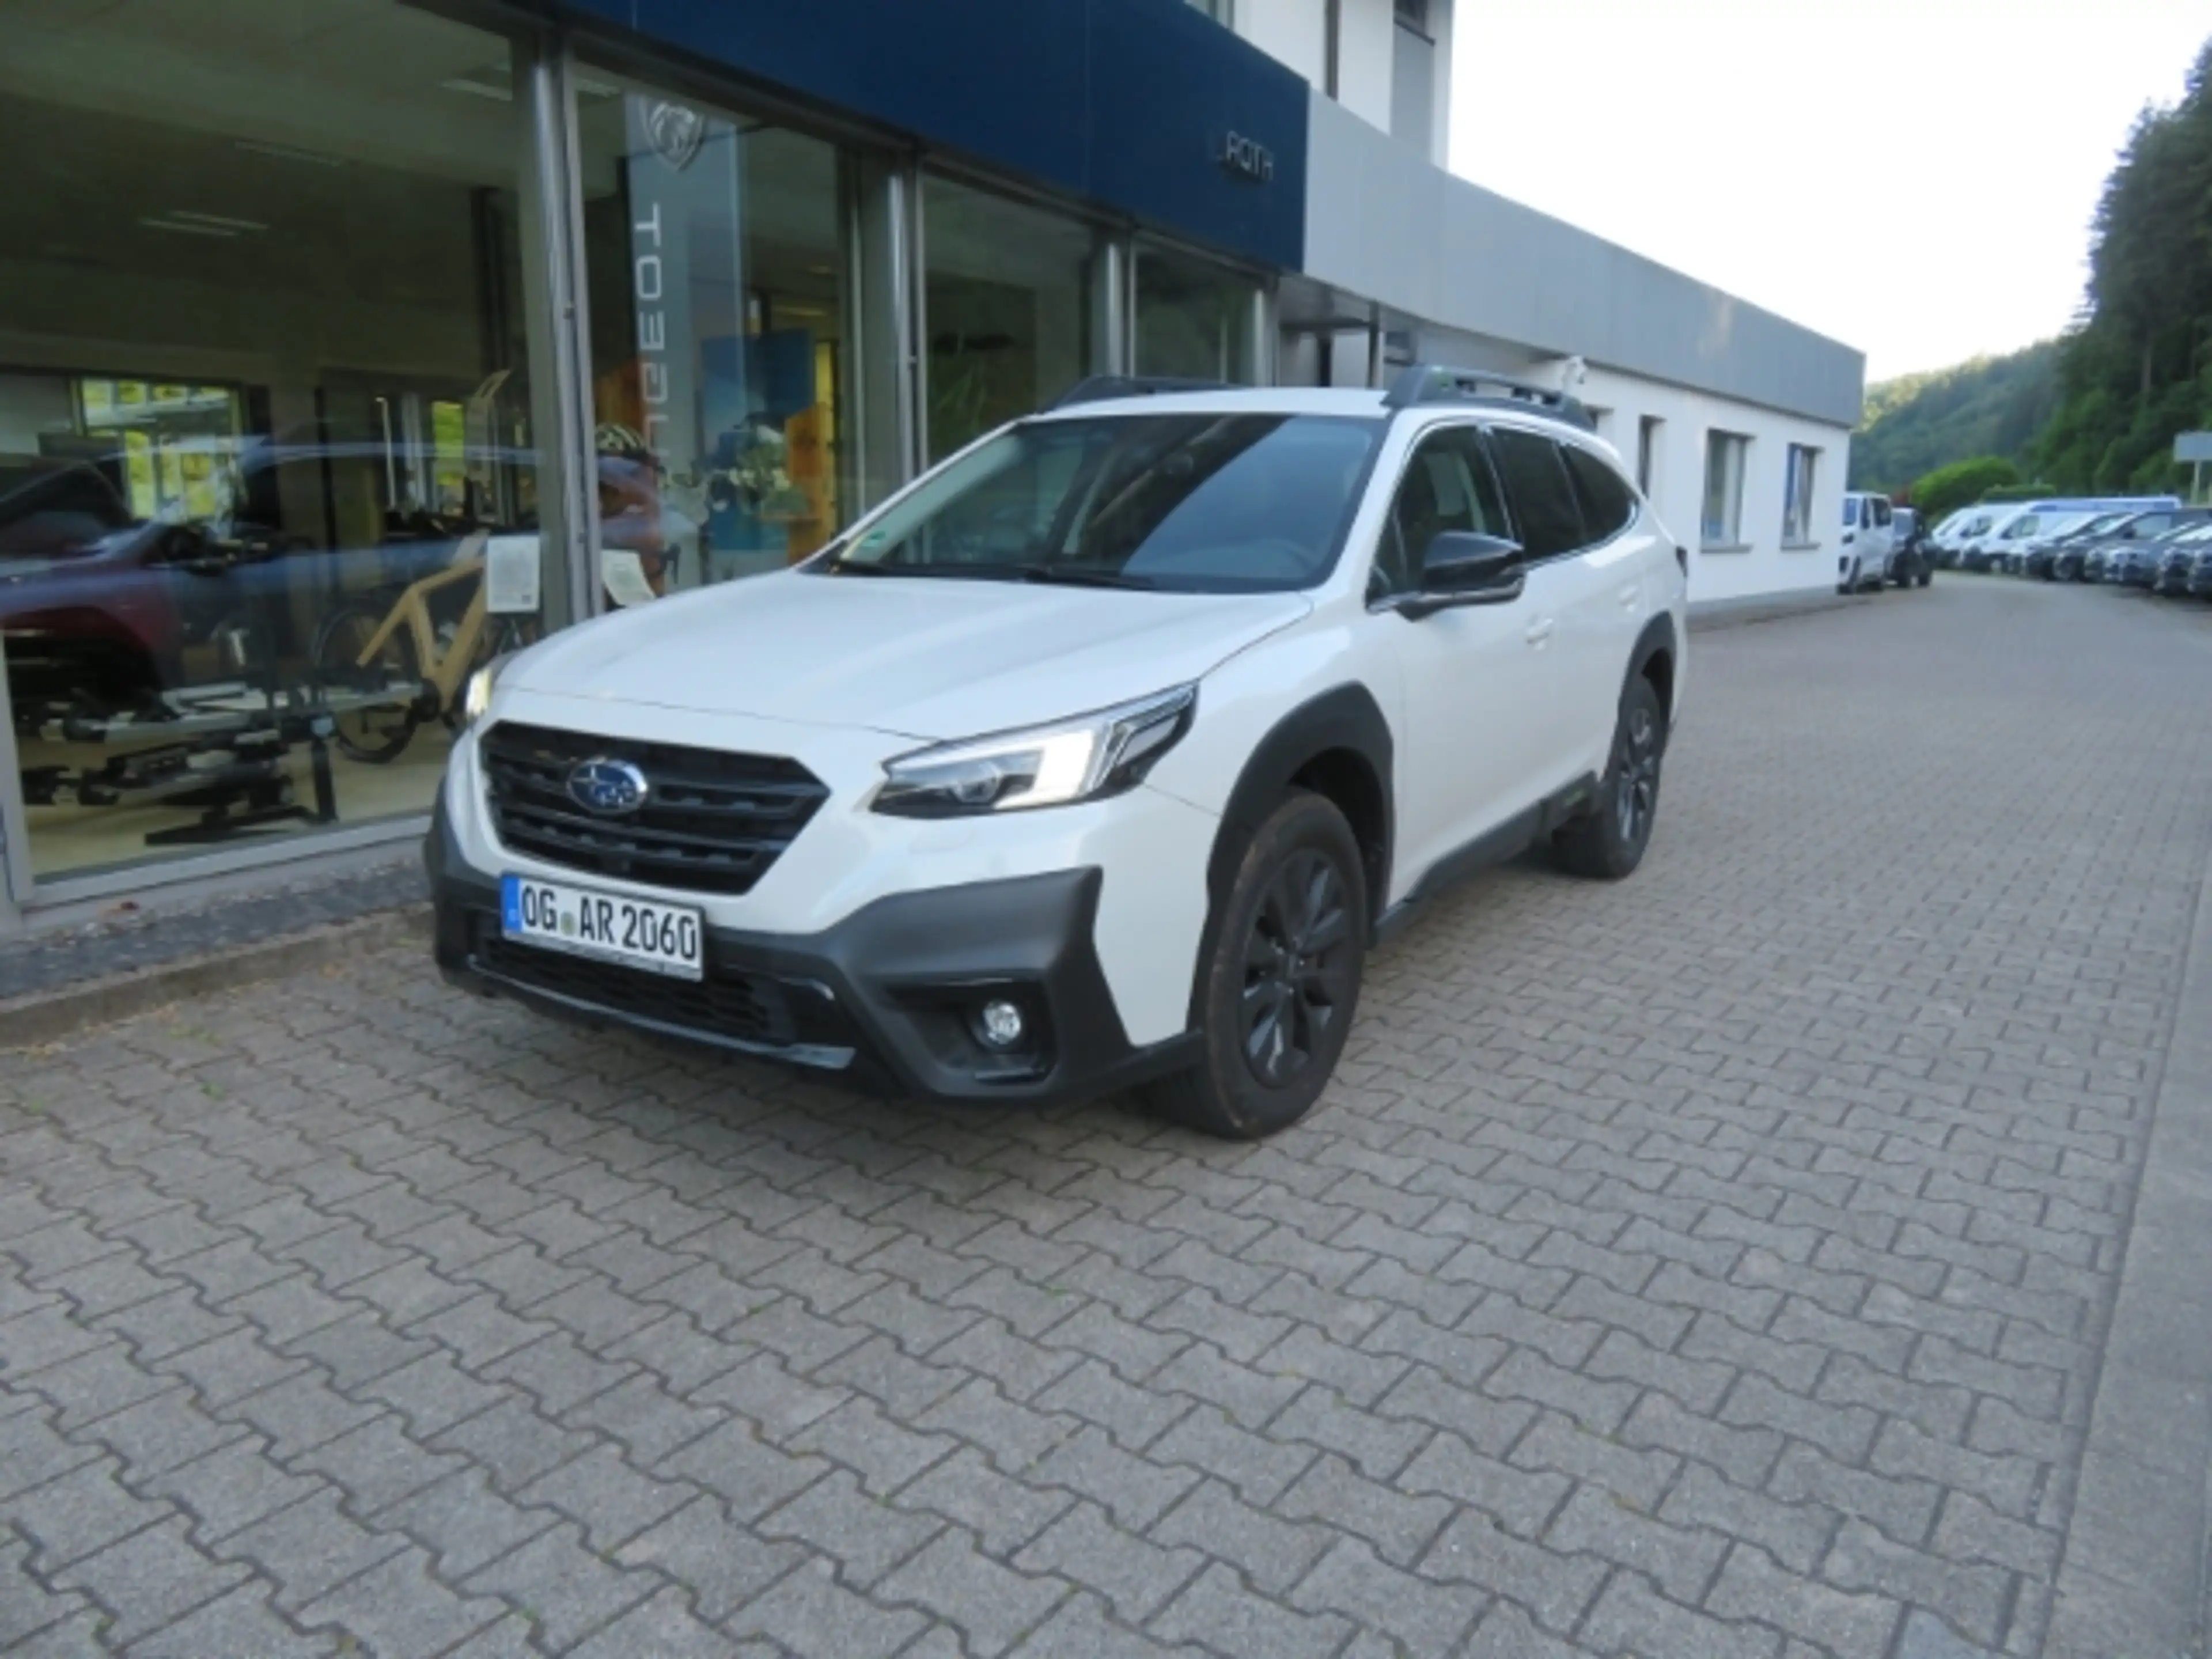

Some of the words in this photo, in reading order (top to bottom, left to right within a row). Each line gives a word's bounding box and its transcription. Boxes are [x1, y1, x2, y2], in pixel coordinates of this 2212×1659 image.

[522, 885, 557, 931] OG
[580, 896, 615, 945] AR
[621, 904, 696, 961] 2060
